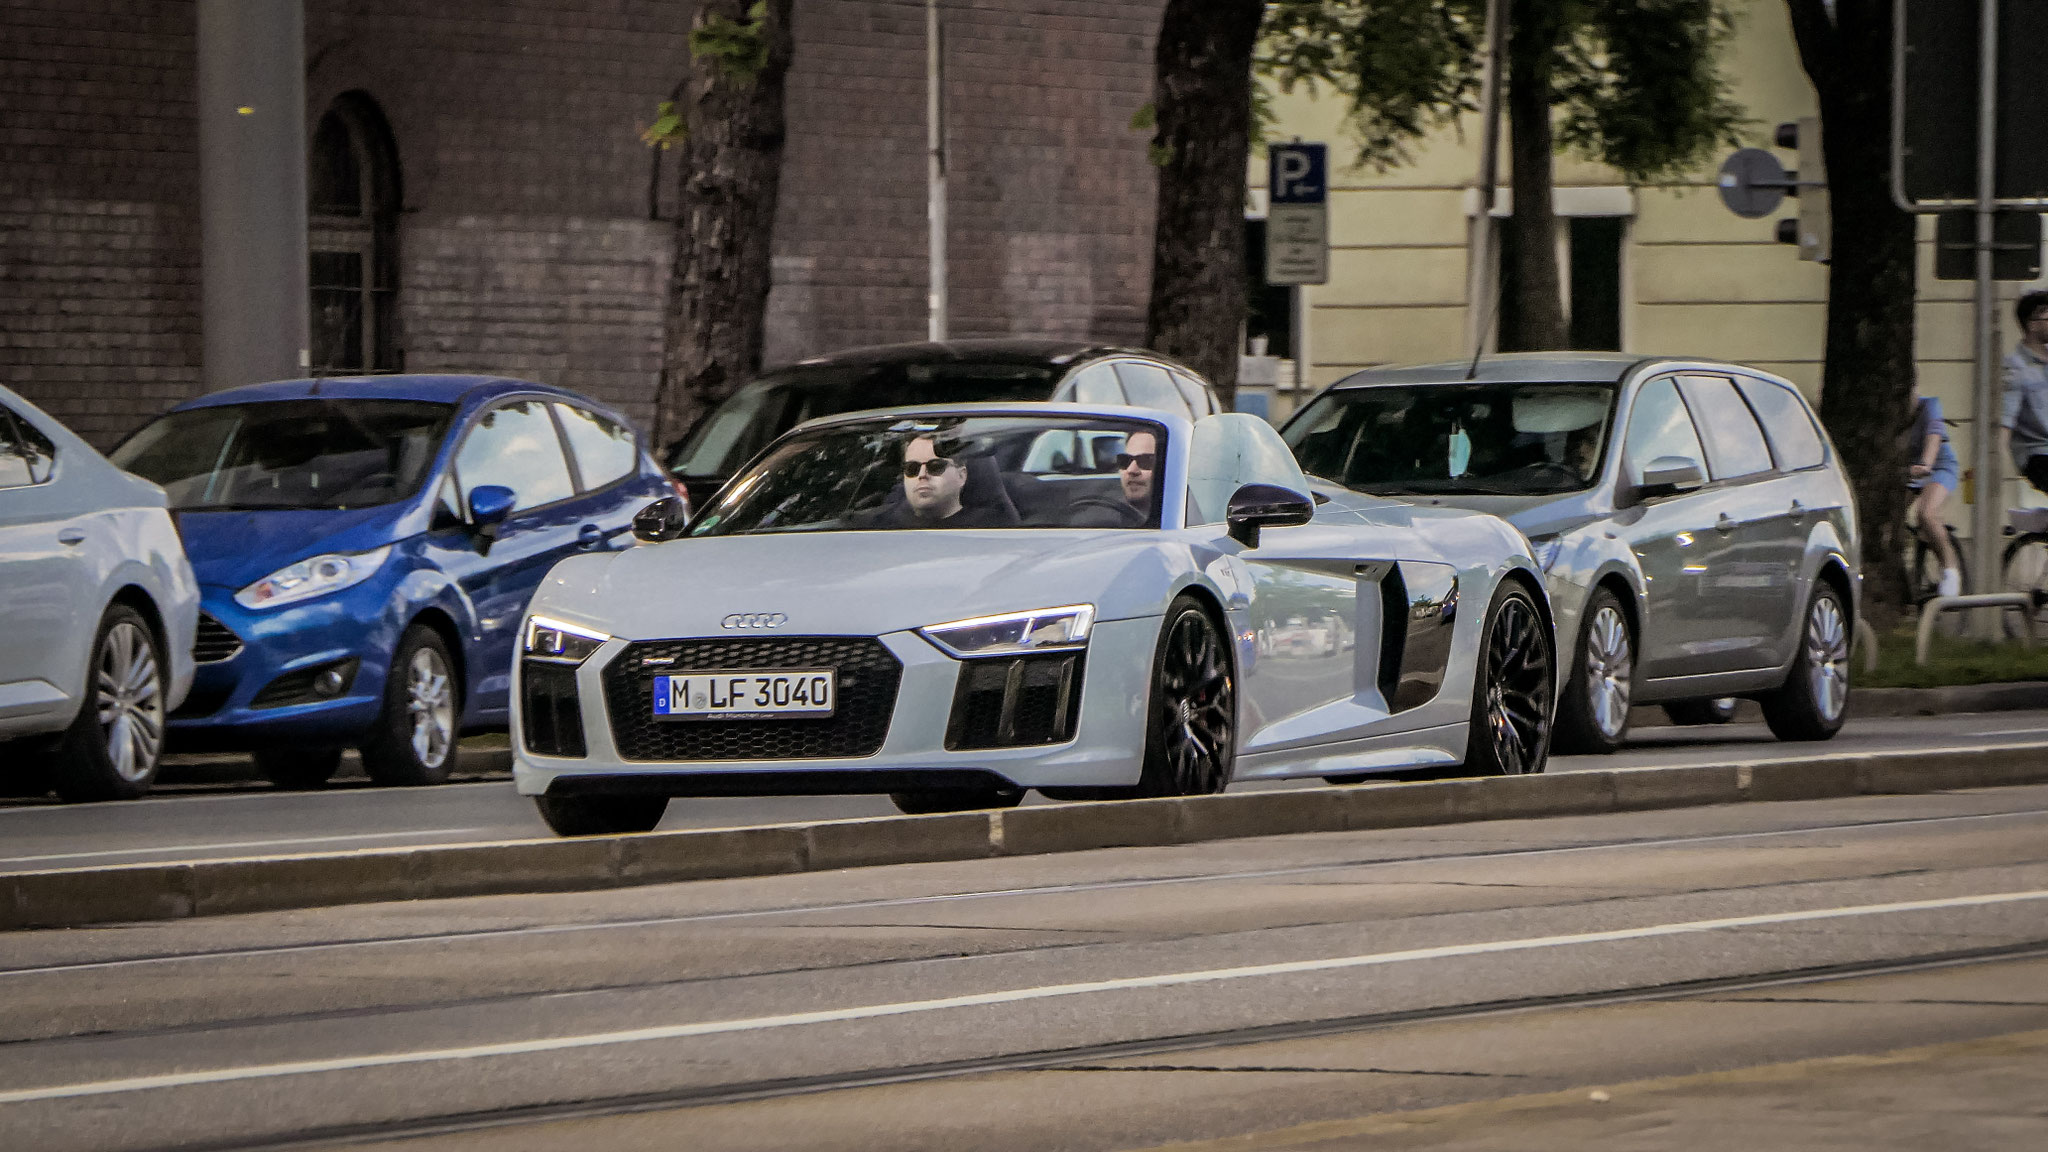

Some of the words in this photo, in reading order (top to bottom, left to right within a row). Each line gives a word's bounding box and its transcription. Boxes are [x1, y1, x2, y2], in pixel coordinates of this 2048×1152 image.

[1276, 151, 1311, 198] P
[659, 699, 666, 707] D
[672, 679, 689, 708] M
[709, 678, 747, 708] LF
[754, 677, 828, 707] 3040
